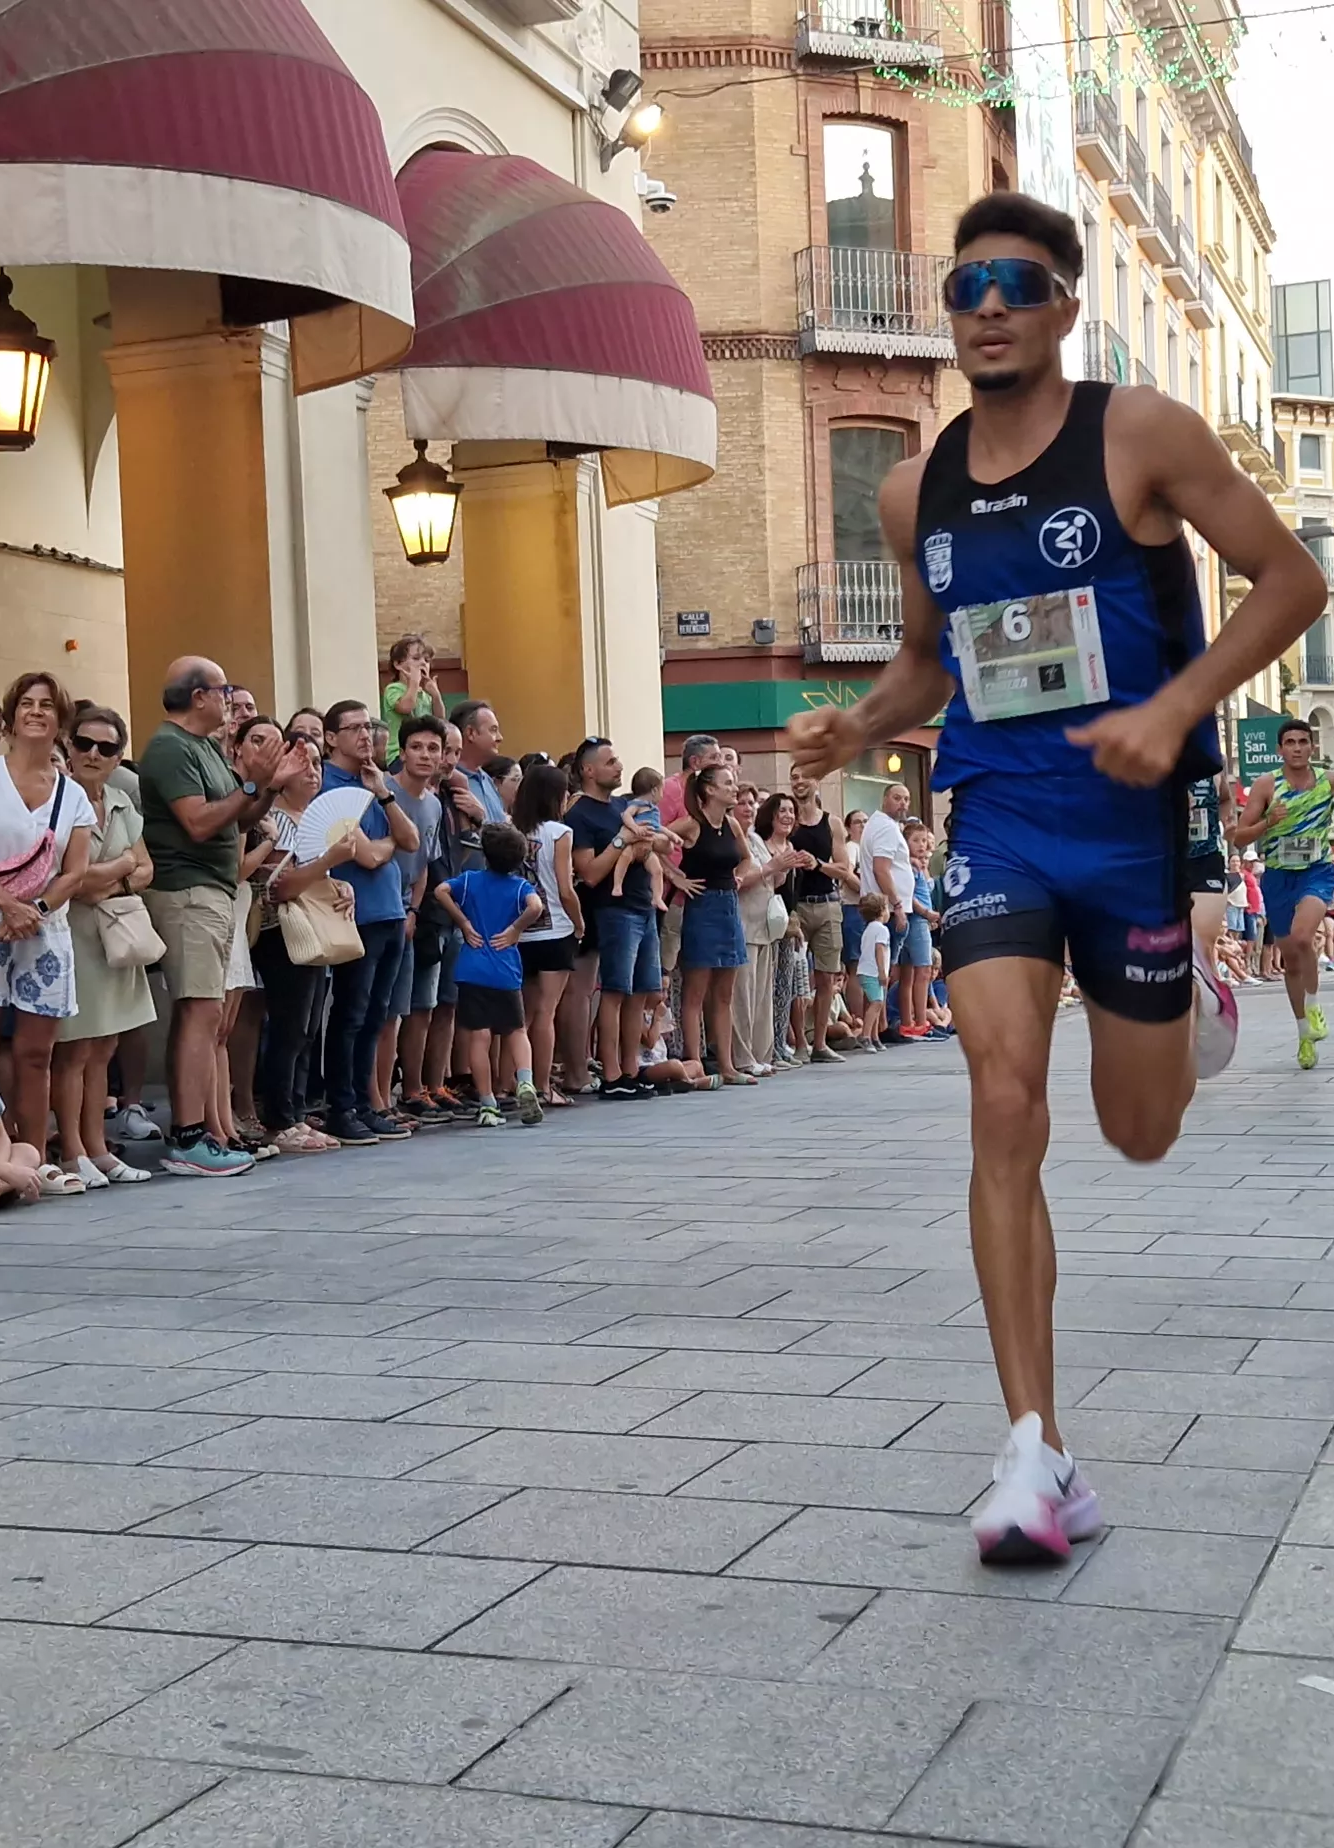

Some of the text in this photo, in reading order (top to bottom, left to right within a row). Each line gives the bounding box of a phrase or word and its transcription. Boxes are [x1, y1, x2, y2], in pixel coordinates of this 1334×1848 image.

[682, 613, 705, 621] CALLE
[1002, 602, 1032, 642] 6
[1244, 731, 1266, 740] vive
[1244, 740, 1267, 752] San
[1245, 753, 1285, 764] Lorenz
[1291, 838, 1309, 848] 12
